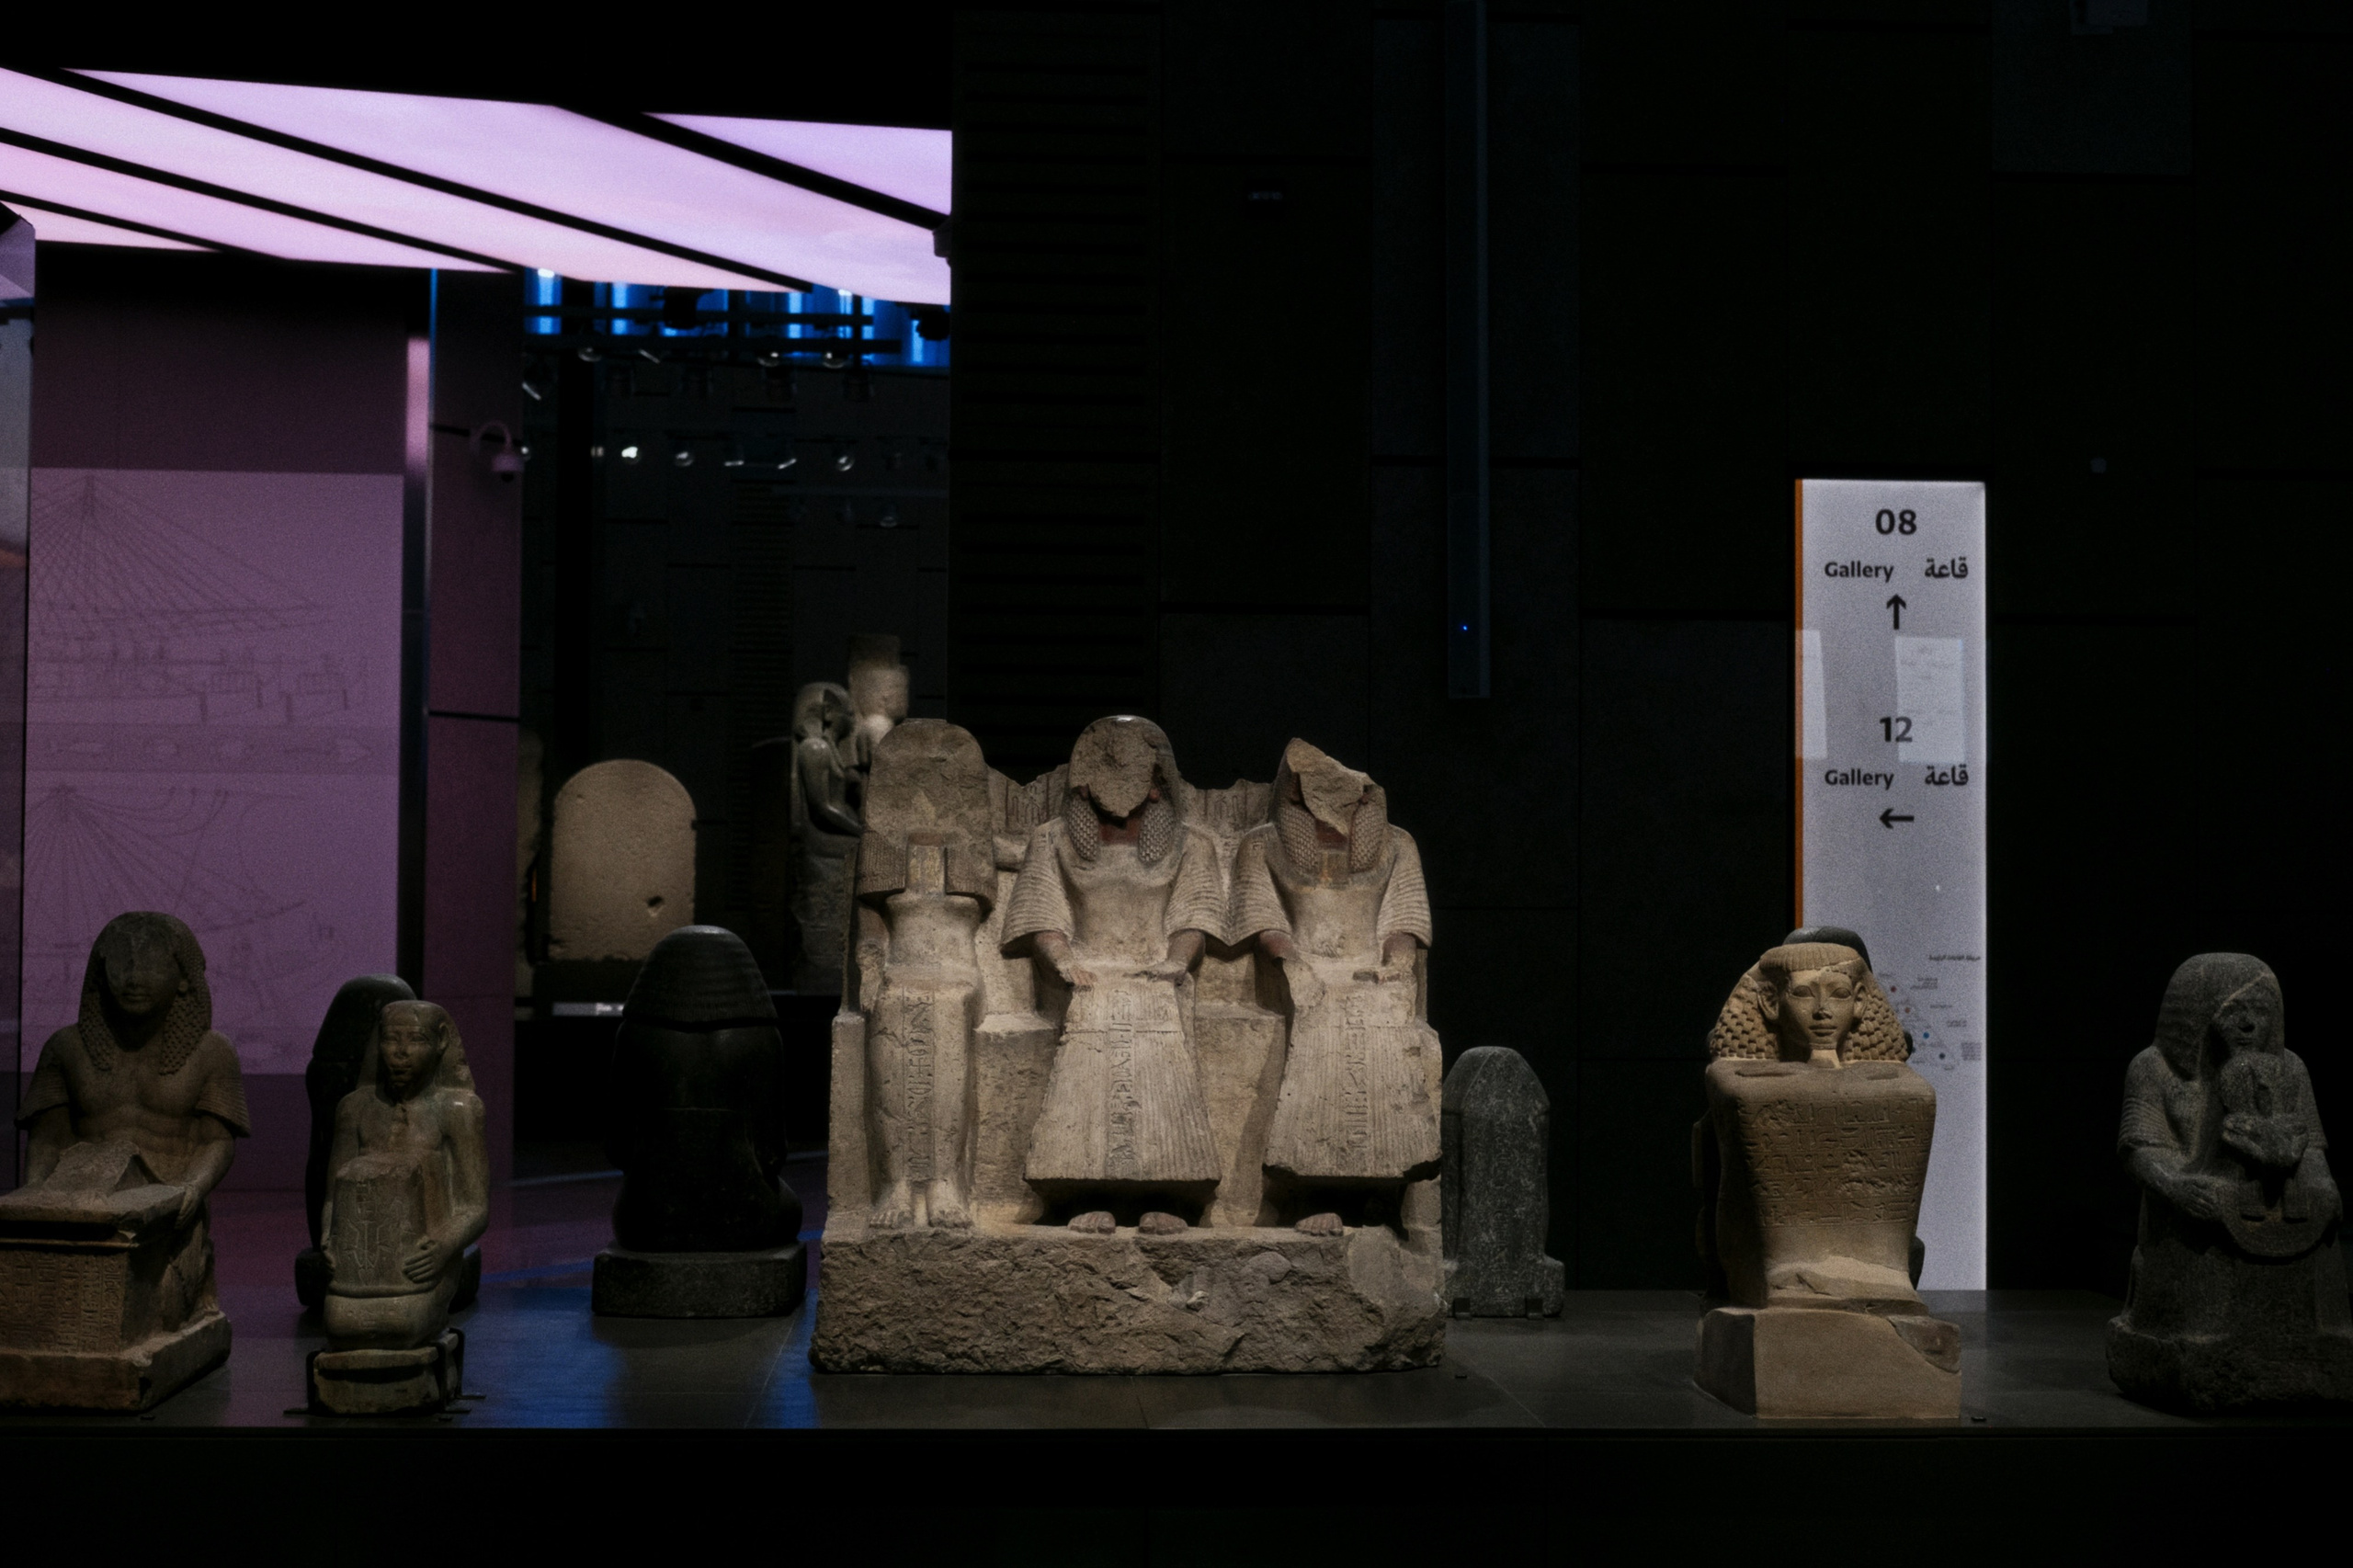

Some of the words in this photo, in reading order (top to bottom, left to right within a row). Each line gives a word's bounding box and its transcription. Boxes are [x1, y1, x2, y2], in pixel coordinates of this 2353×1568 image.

[1875, 509, 1916, 535] 08
[1824, 562, 1894, 582] Gallery
[1925, 557, 1968, 579] قاعة
[1880, 717, 1913, 742] 12
[1824, 769, 1894, 790] Gallery
[1925, 765, 1968, 787] قاعة
